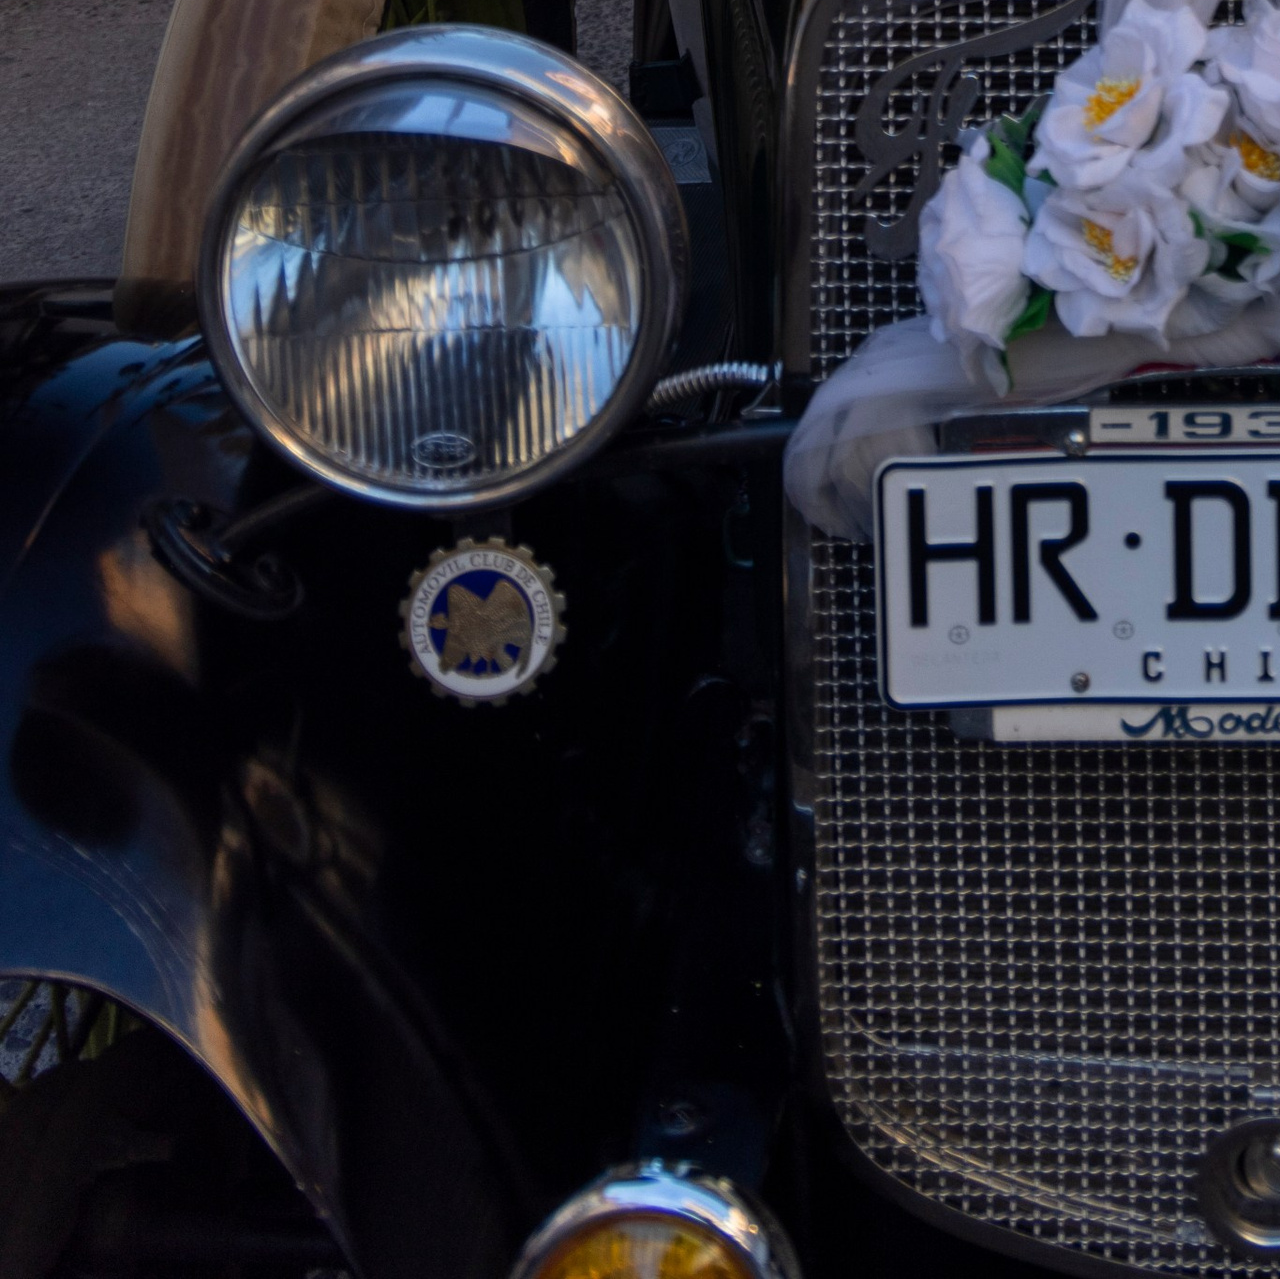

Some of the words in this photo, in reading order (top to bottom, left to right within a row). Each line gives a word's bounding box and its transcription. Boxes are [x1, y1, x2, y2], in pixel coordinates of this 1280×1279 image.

[412, 559, 466, 654] AUTOMOVIL
[470, 553, 515, 572] CLUB
[515, 566, 537, 588] DE
[532, 590, 551, 647] CHILE
